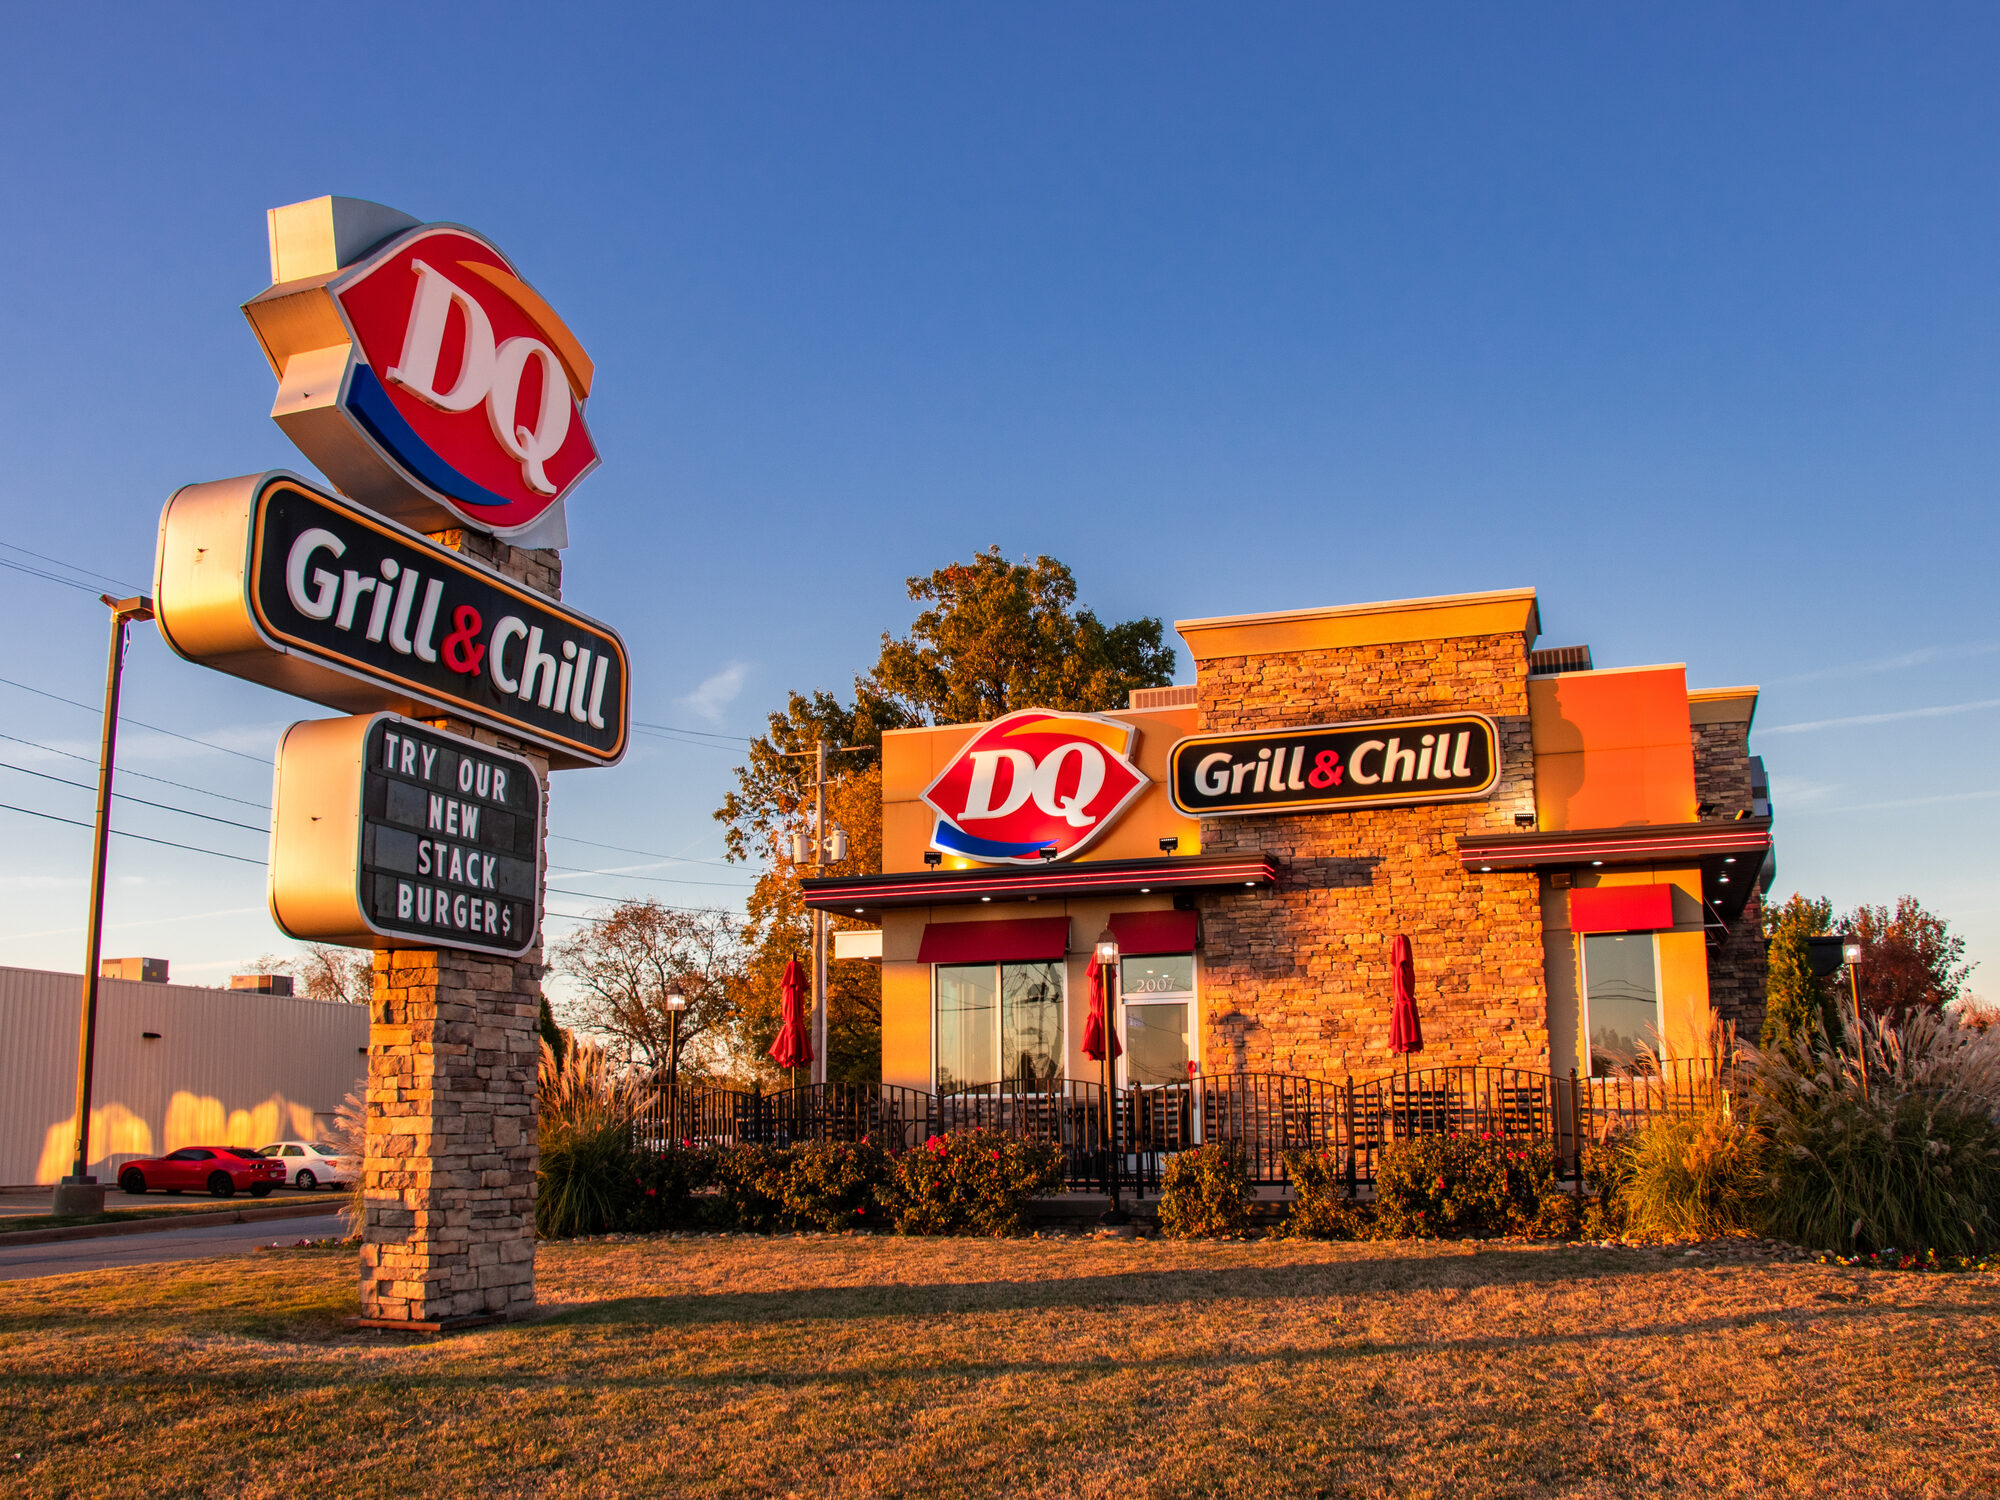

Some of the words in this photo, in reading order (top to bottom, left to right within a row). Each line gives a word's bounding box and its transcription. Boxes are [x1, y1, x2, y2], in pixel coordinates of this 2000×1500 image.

[386, 259, 572, 495] DQ
[384, 732, 437, 780] TRY
[458, 758, 506, 802] OUR
[957, 742, 1106, 827] DQ
[428, 795, 480, 839] NEW
[418, 839, 497, 889] STACK
[1136, 977, 1176, 993] 2007
